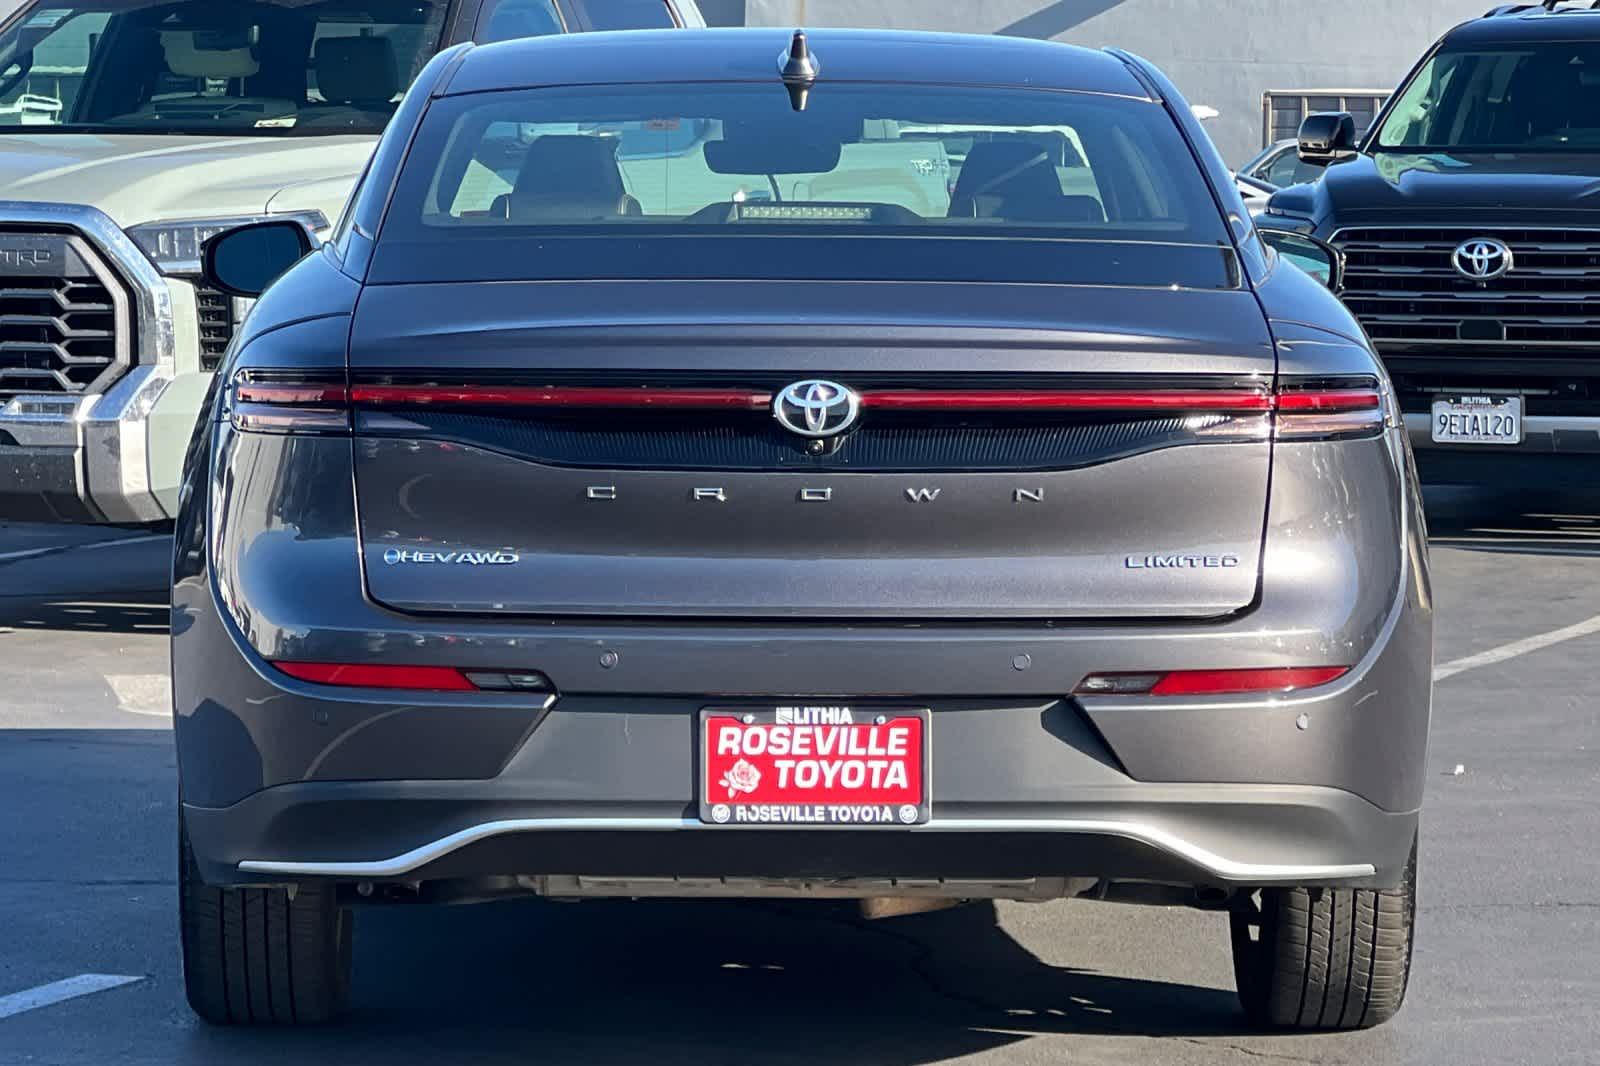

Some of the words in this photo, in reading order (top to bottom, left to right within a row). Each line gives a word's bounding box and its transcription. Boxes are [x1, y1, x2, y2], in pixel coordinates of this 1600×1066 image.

[1438, 414, 1514, 436] 9EIA120
[587, 485, 1044, 501] CROWN
[456, 551, 519, 564] AWD
[1125, 556, 1240, 569] LIMITED
[794, 707, 853, 725] LITHIA
[717, 727, 909, 755] ROSEVILLE
[774, 760, 909, 789] TOYOTA
[736, 805, 825, 822] ROSEVILLE
